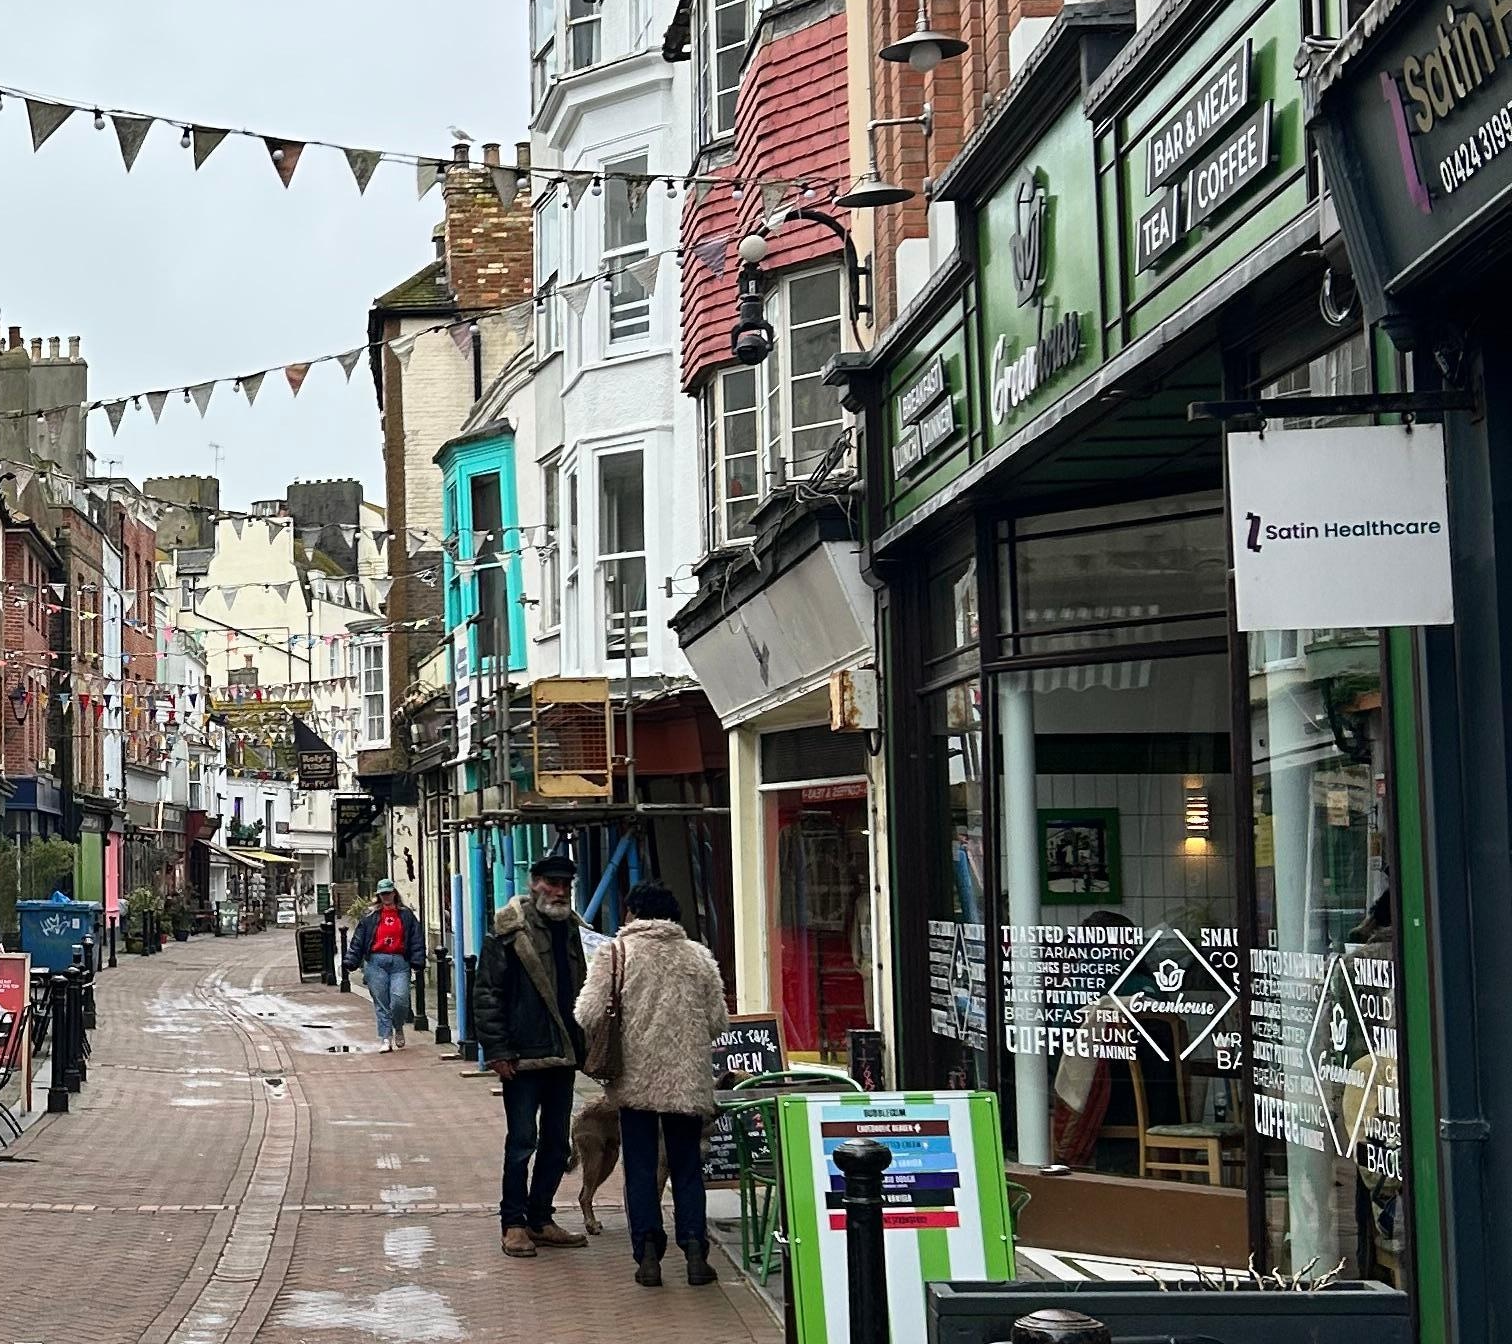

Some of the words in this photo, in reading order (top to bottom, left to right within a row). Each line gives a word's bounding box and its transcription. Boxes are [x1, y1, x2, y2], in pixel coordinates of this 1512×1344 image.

[1403, 3, 1496, 134] Satin
[1153, 120, 1184, 179] BAR
[1184, 109, 1196, 149] &
[1196, 62, 1239, 137] MEZE
[1439, 136, 1482, 194] 01424
[1478, 99, 1512, 160] 3199
[1196, 123, 1258, 209] COFFEE
[1142, 205, 1171, 256] TEA
[990, 300, 1081, 425] Greenhouse
[1266, 522, 1318, 540] Satin
[1324, 520, 1441, 538] Healthcare
[1000, 925, 1064, 944] TOASTED
[1067, 926, 1144, 945] SANDWICH
[1001, 945, 1088, 959] VEGETARIAN
[1003, 975, 1042, 987] MEZE
[1044, 977, 1106, 989] PLATTER
[1062, 962, 1121, 975] BURGERS
[1354, 957, 1390, 988] SNACKS
[1004, 988, 1044, 1003] JACKET
[1046, 990, 1101, 1006] POTATOES
[1129, 991, 1217, 1016] Greenhouse
[1360, 993, 1392, 1021] COLD
[1004, 1007, 1090, 1023] BREAKFAST
[1096, 1010, 1120, 1023] FISH
[1006, 1024, 1090, 1058] COFFEE
[1093, 1044, 1137, 1061] PANINIS
[726, 1051, 763, 1073] OPEN
[1318, 1050, 1365, 1089] Greenhouse
[1253, 1066, 1299, 1094] BREAKFAST
[1253, 1093, 1299, 1145] COFFEE
